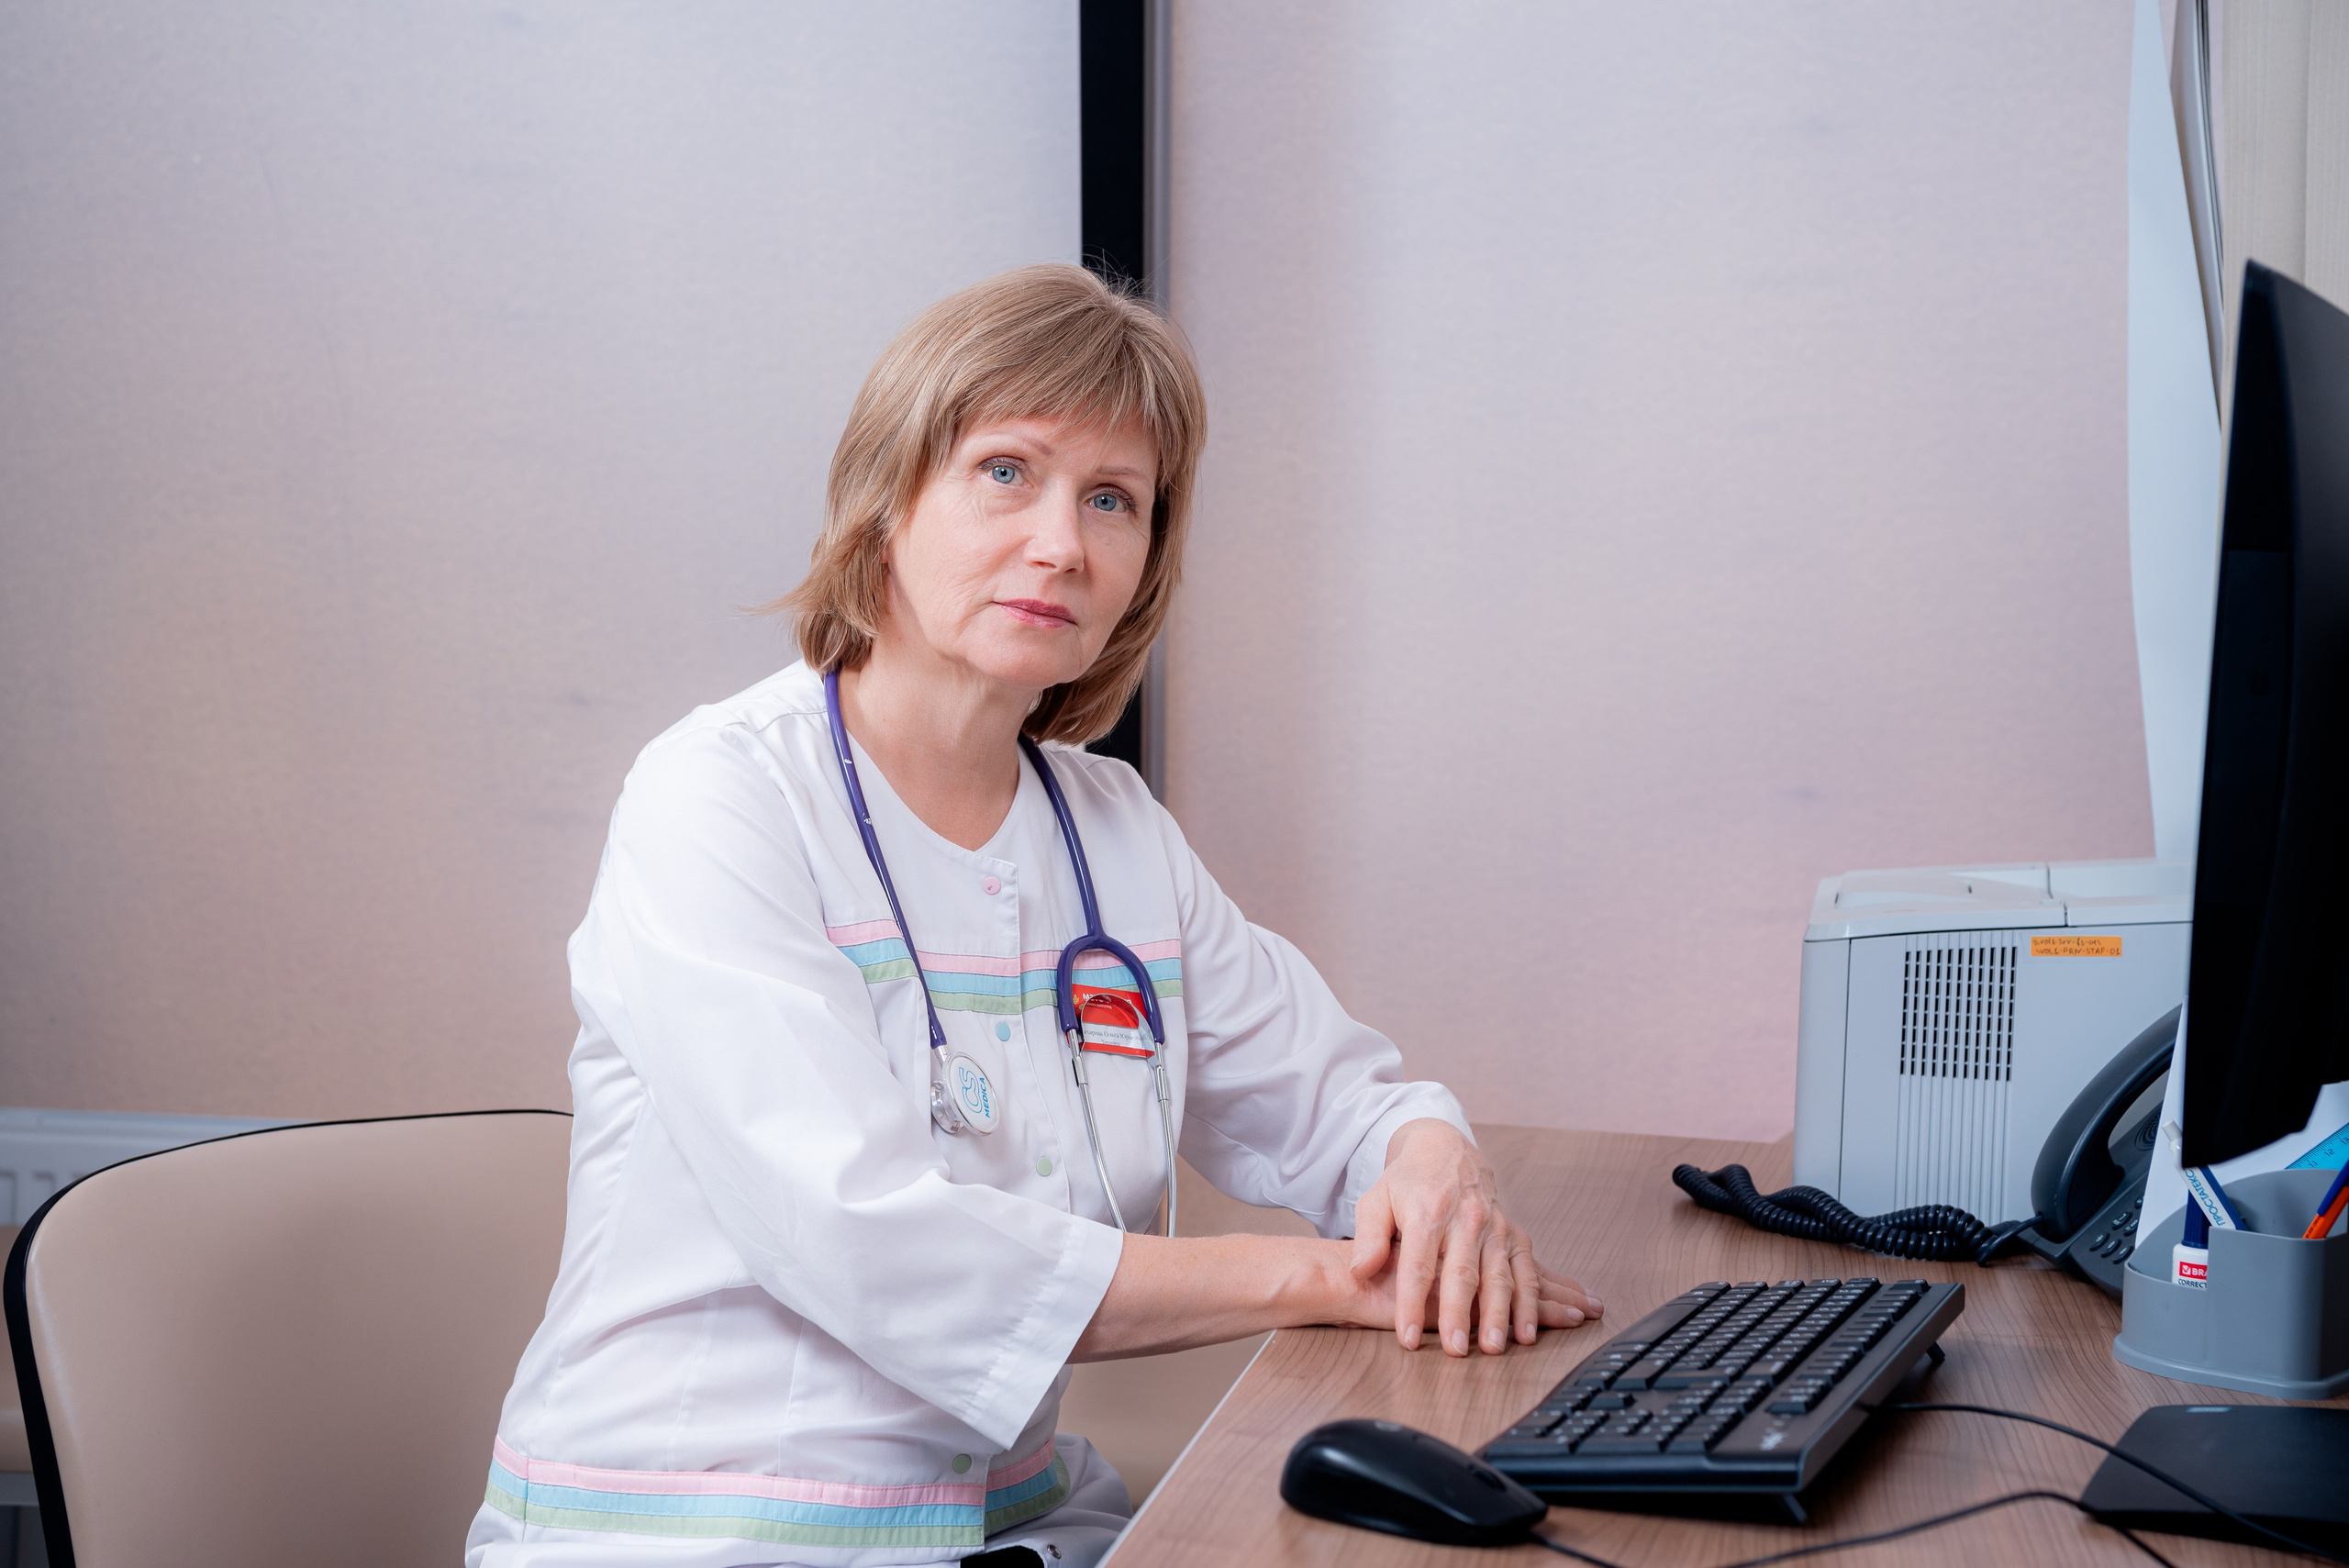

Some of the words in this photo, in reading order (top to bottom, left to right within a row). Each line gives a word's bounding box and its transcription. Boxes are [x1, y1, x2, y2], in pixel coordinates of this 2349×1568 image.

[979, 1077, 991, 1118] MEDICA
[2324, 1148, 2335, 1157] 12
[2185, 1169, 2226, 1226] ПРОСТАТЕКС
